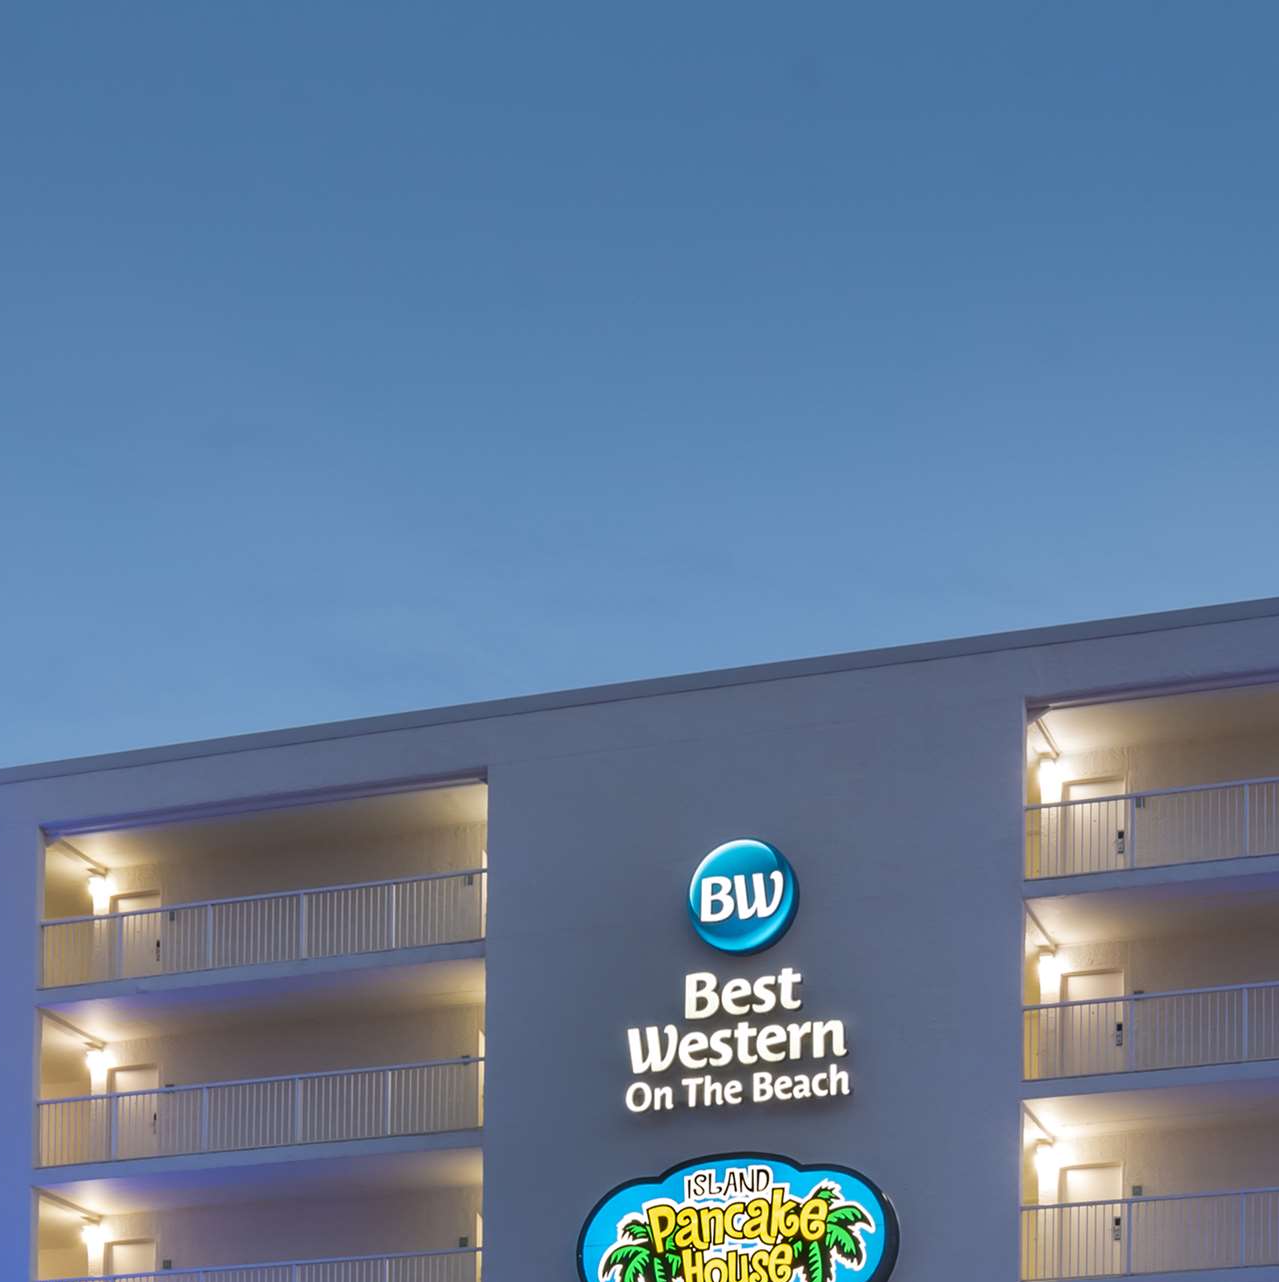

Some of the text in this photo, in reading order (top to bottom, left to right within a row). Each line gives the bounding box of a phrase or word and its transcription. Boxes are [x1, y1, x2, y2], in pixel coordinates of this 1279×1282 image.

[700, 870, 784, 923] BW
[685, 967, 801, 1020] Best
[627, 1019, 847, 1074] Western
[625, 1064, 850, 1112] On The Beach
[687, 1169, 770, 1199] ISLAND
[647, 1188, 828, 1253] Pancake
